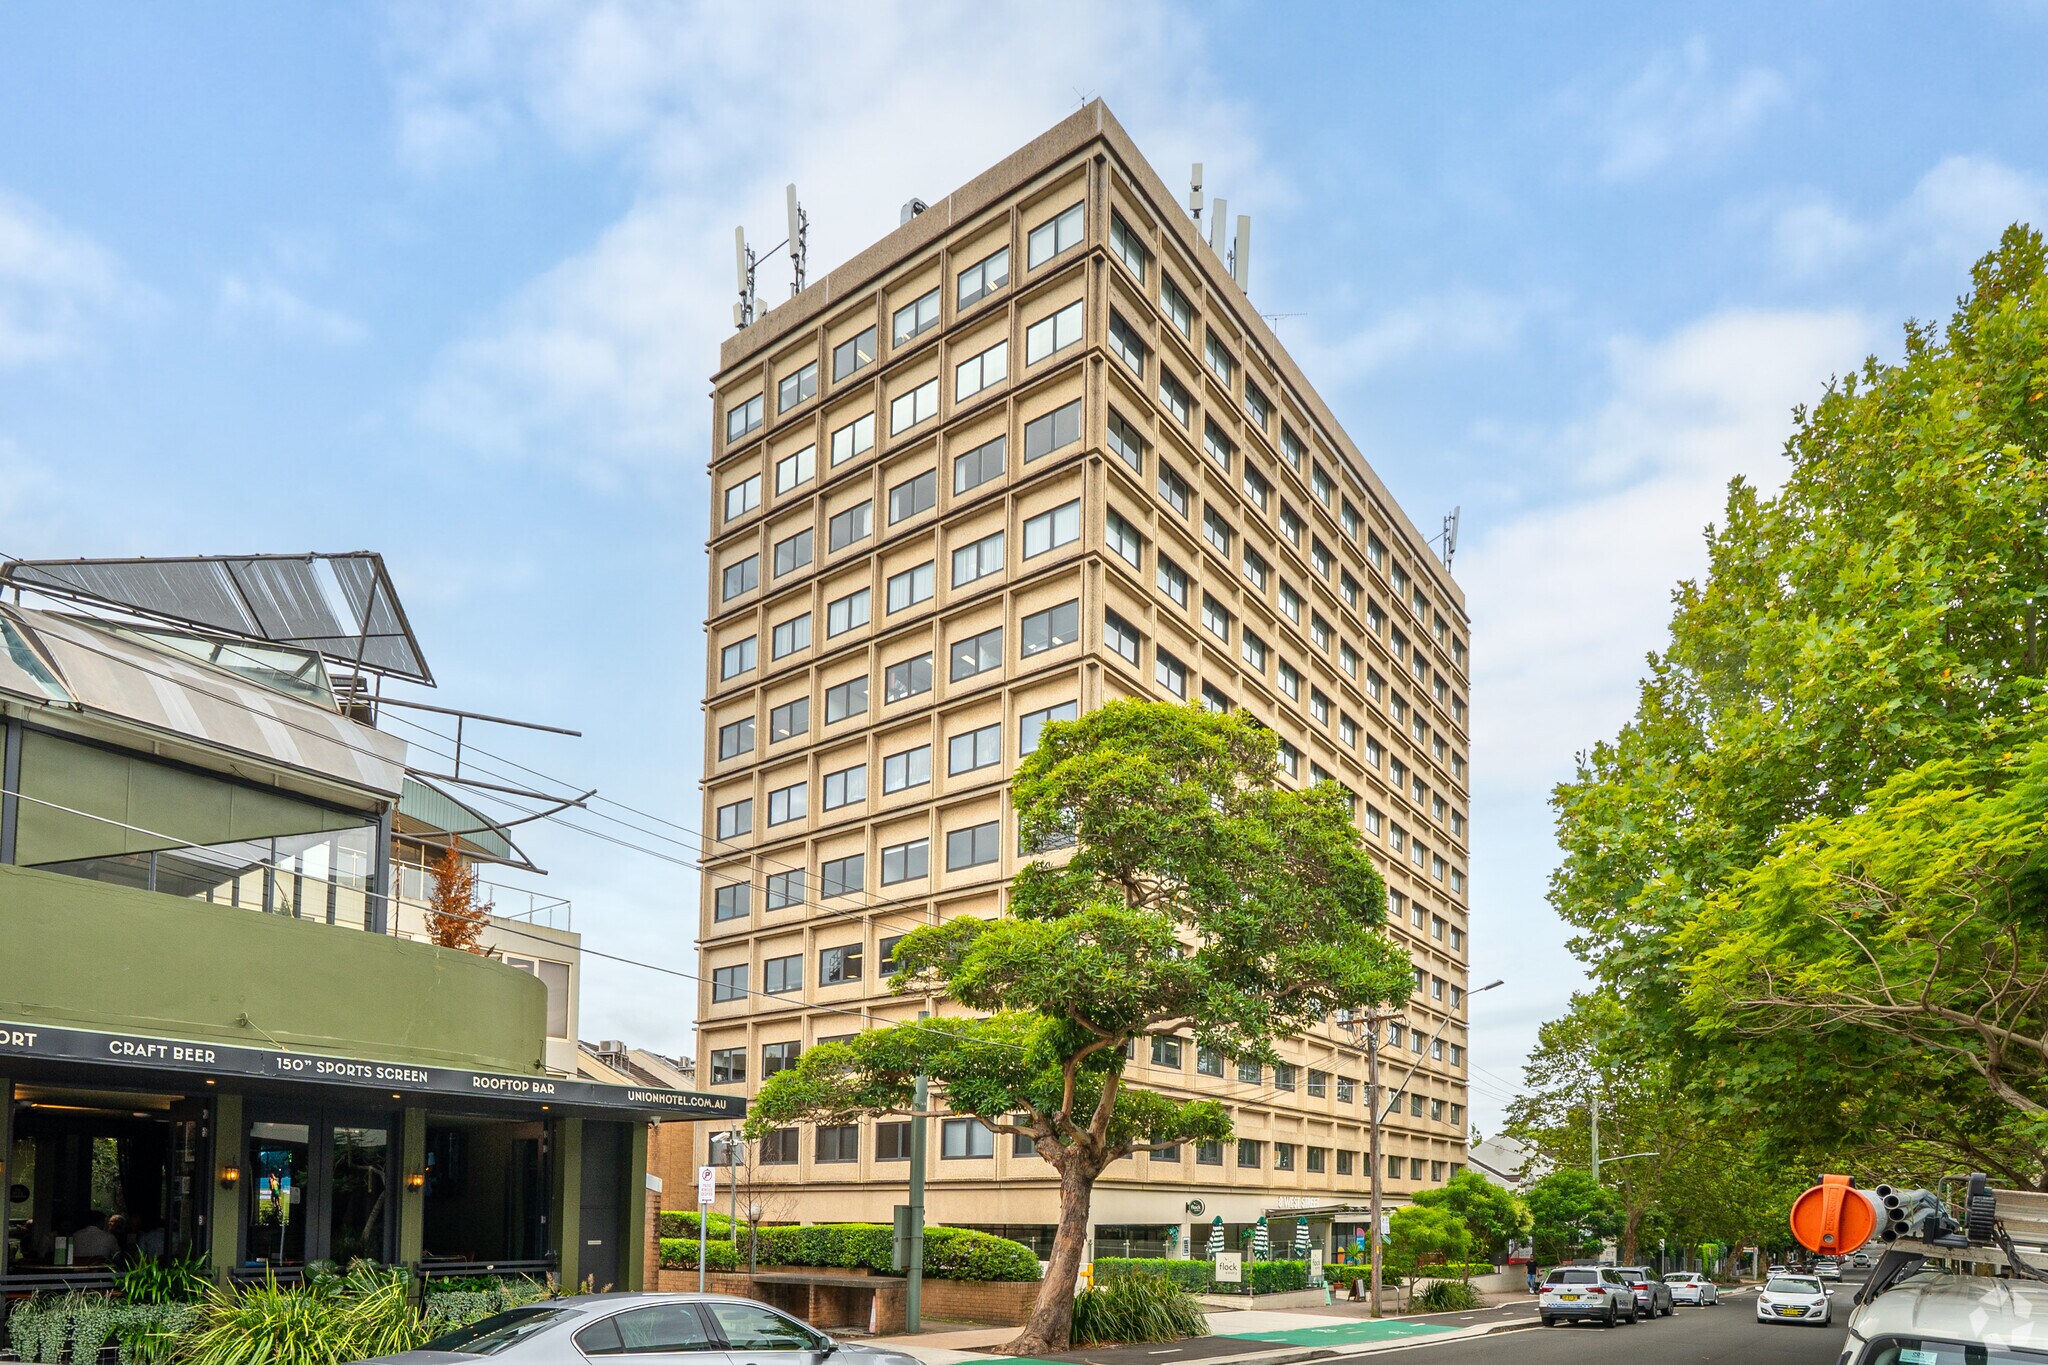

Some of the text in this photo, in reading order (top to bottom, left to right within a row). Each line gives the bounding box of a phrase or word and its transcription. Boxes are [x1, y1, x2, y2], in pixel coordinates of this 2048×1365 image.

[0, 1030, 38, 1048] ORT
[109, 1040, 216, 1064] CRAFT BEER
[316, 1061, 373, 1078] SPORTS
[376, 1067, 428, 1083] SCREEN
[472, 1076, 555, 1095] ROOFTOP BAR
[627, 1090, 727, 1110] UNIONHOTEL.COM.AU
[1284, 1196, 1299, 1209] WEST
[1300, 1197, 1320, 1209] STREET
[1219, 1262, 1238, 1271] flock
